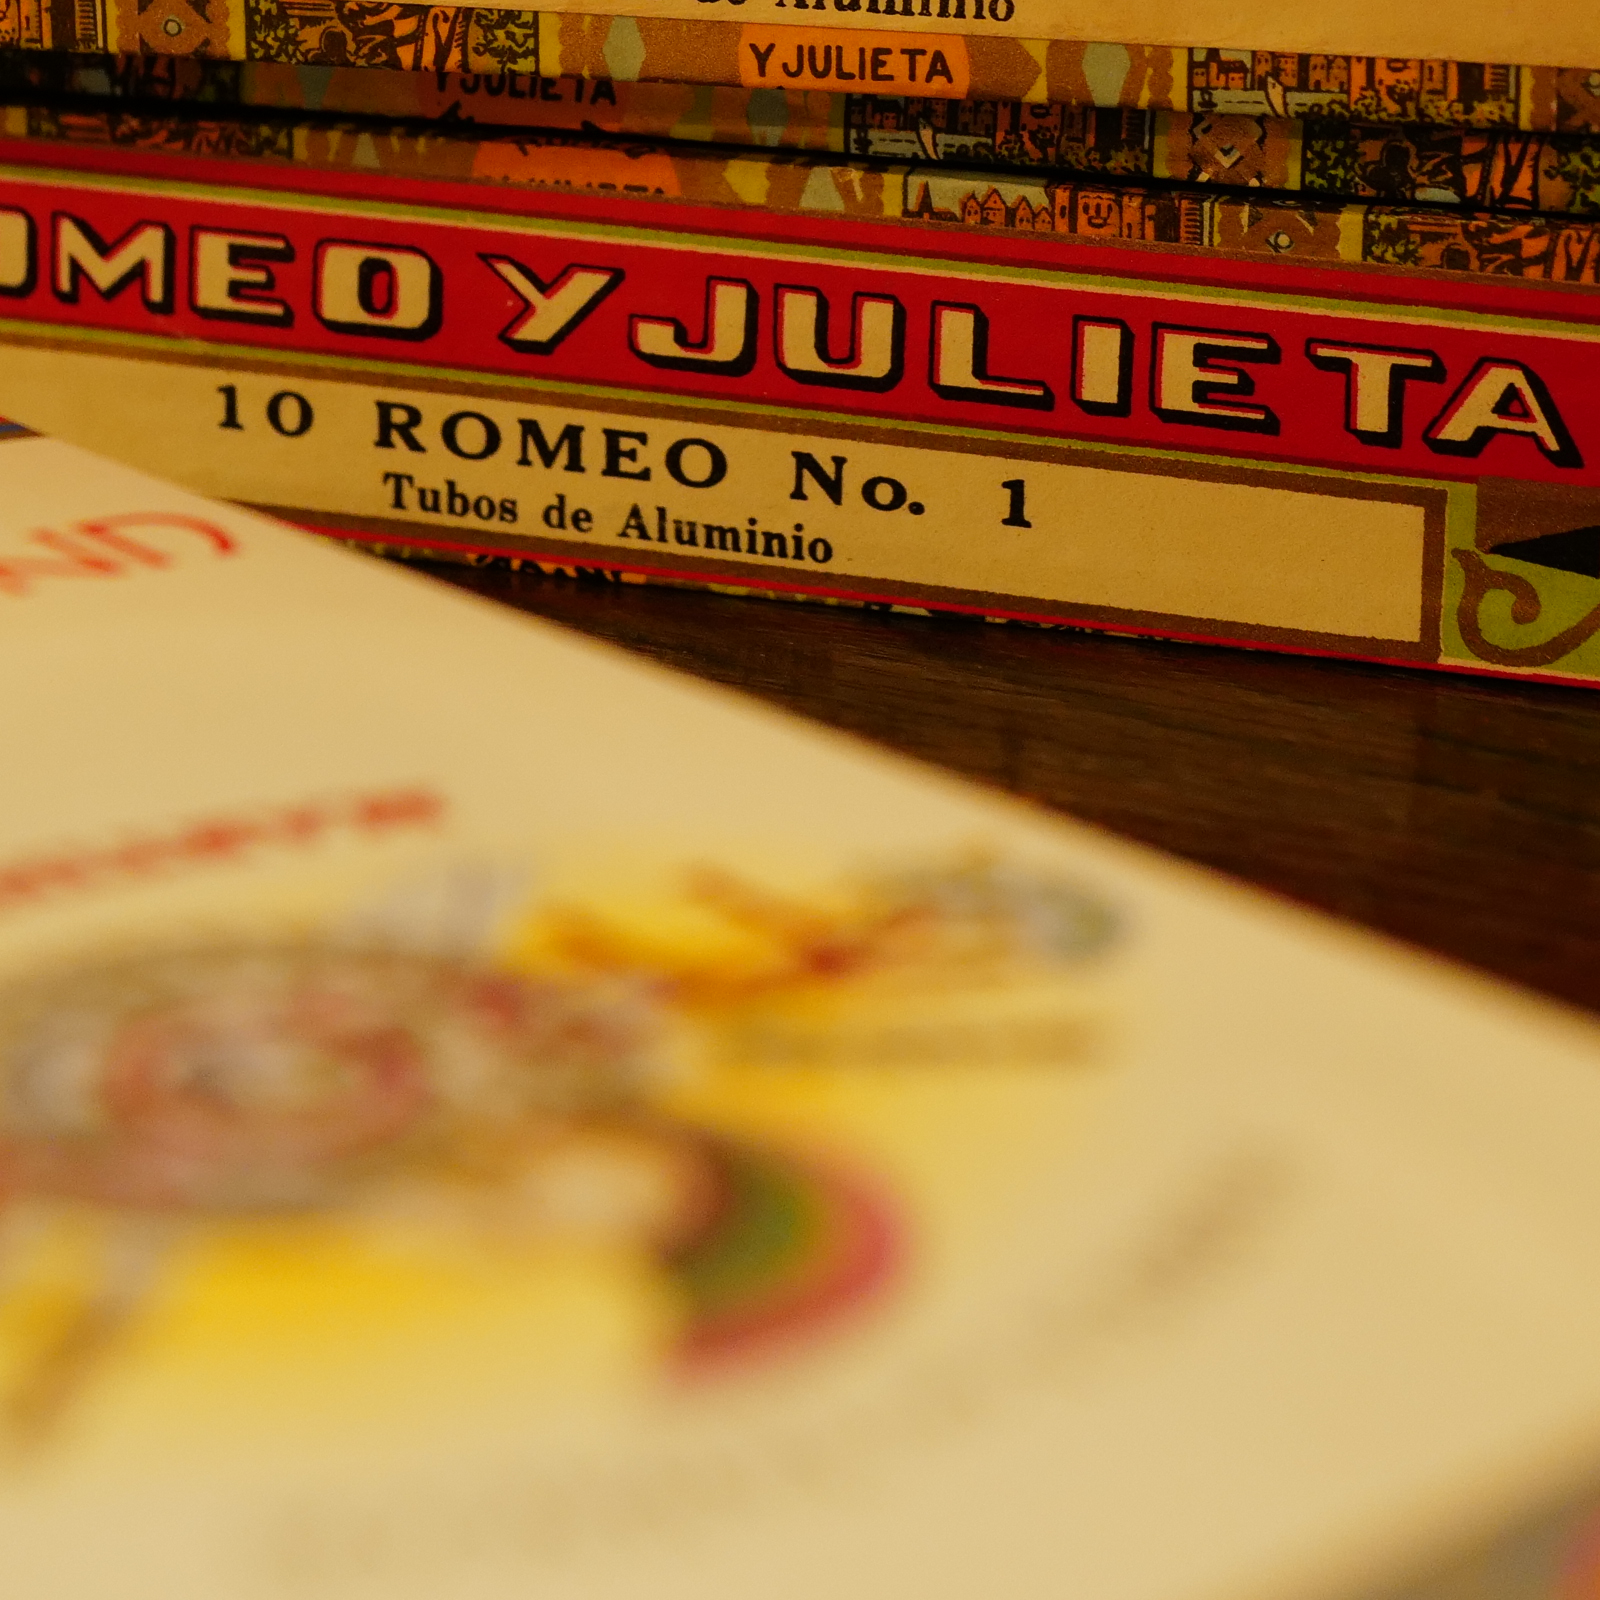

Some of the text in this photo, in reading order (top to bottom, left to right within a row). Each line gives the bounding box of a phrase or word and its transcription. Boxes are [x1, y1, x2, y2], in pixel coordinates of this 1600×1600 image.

[781, 43, 954, 85] JULIETA
[476, 252, 625, 355] Y
[628, 275, 1585, 469] JULIETA
[216, 384, 1033, 529] 10 ROMEO No. 1
[382, 472, 834, 564] Tubos de Aluminio
